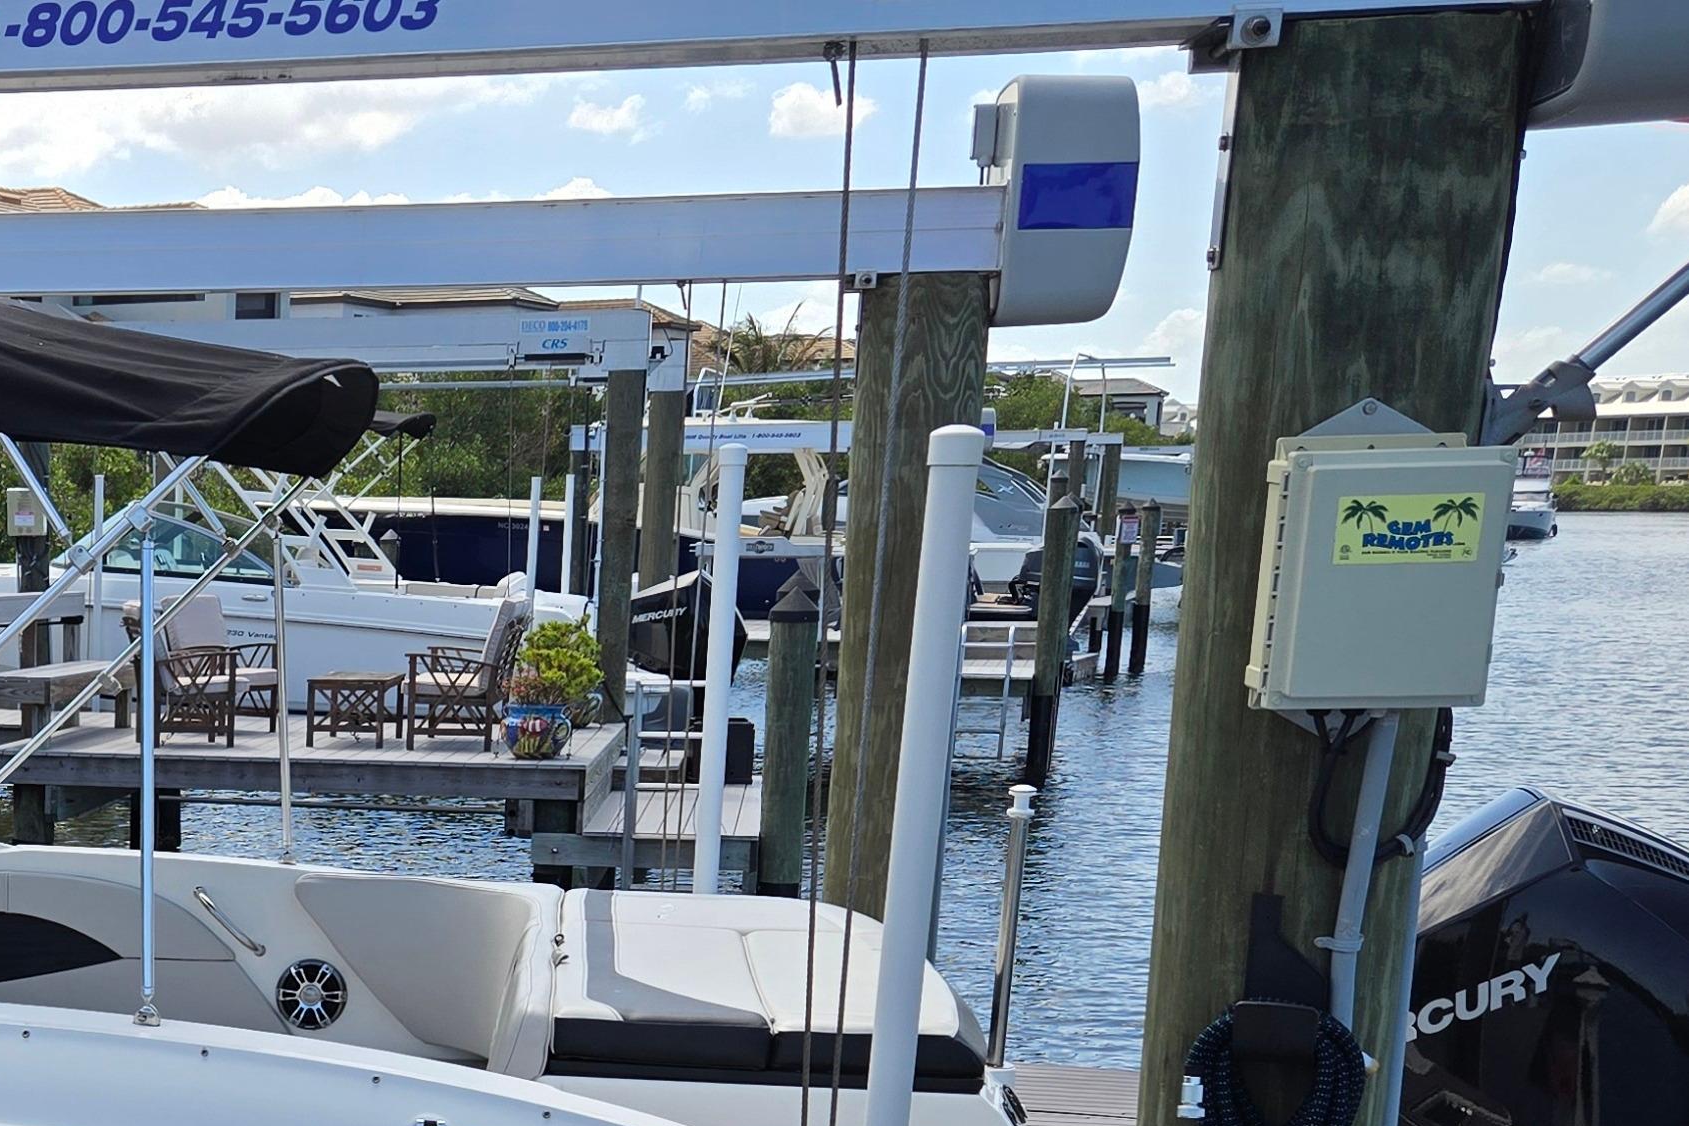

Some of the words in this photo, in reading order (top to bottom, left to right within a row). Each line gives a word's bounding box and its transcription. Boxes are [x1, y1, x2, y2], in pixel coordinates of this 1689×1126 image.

[542, 338, 569, 350] CRS
[1387, 519, 1432, 536] GEM
[1362, 531, 1454, 550] REMOTES
